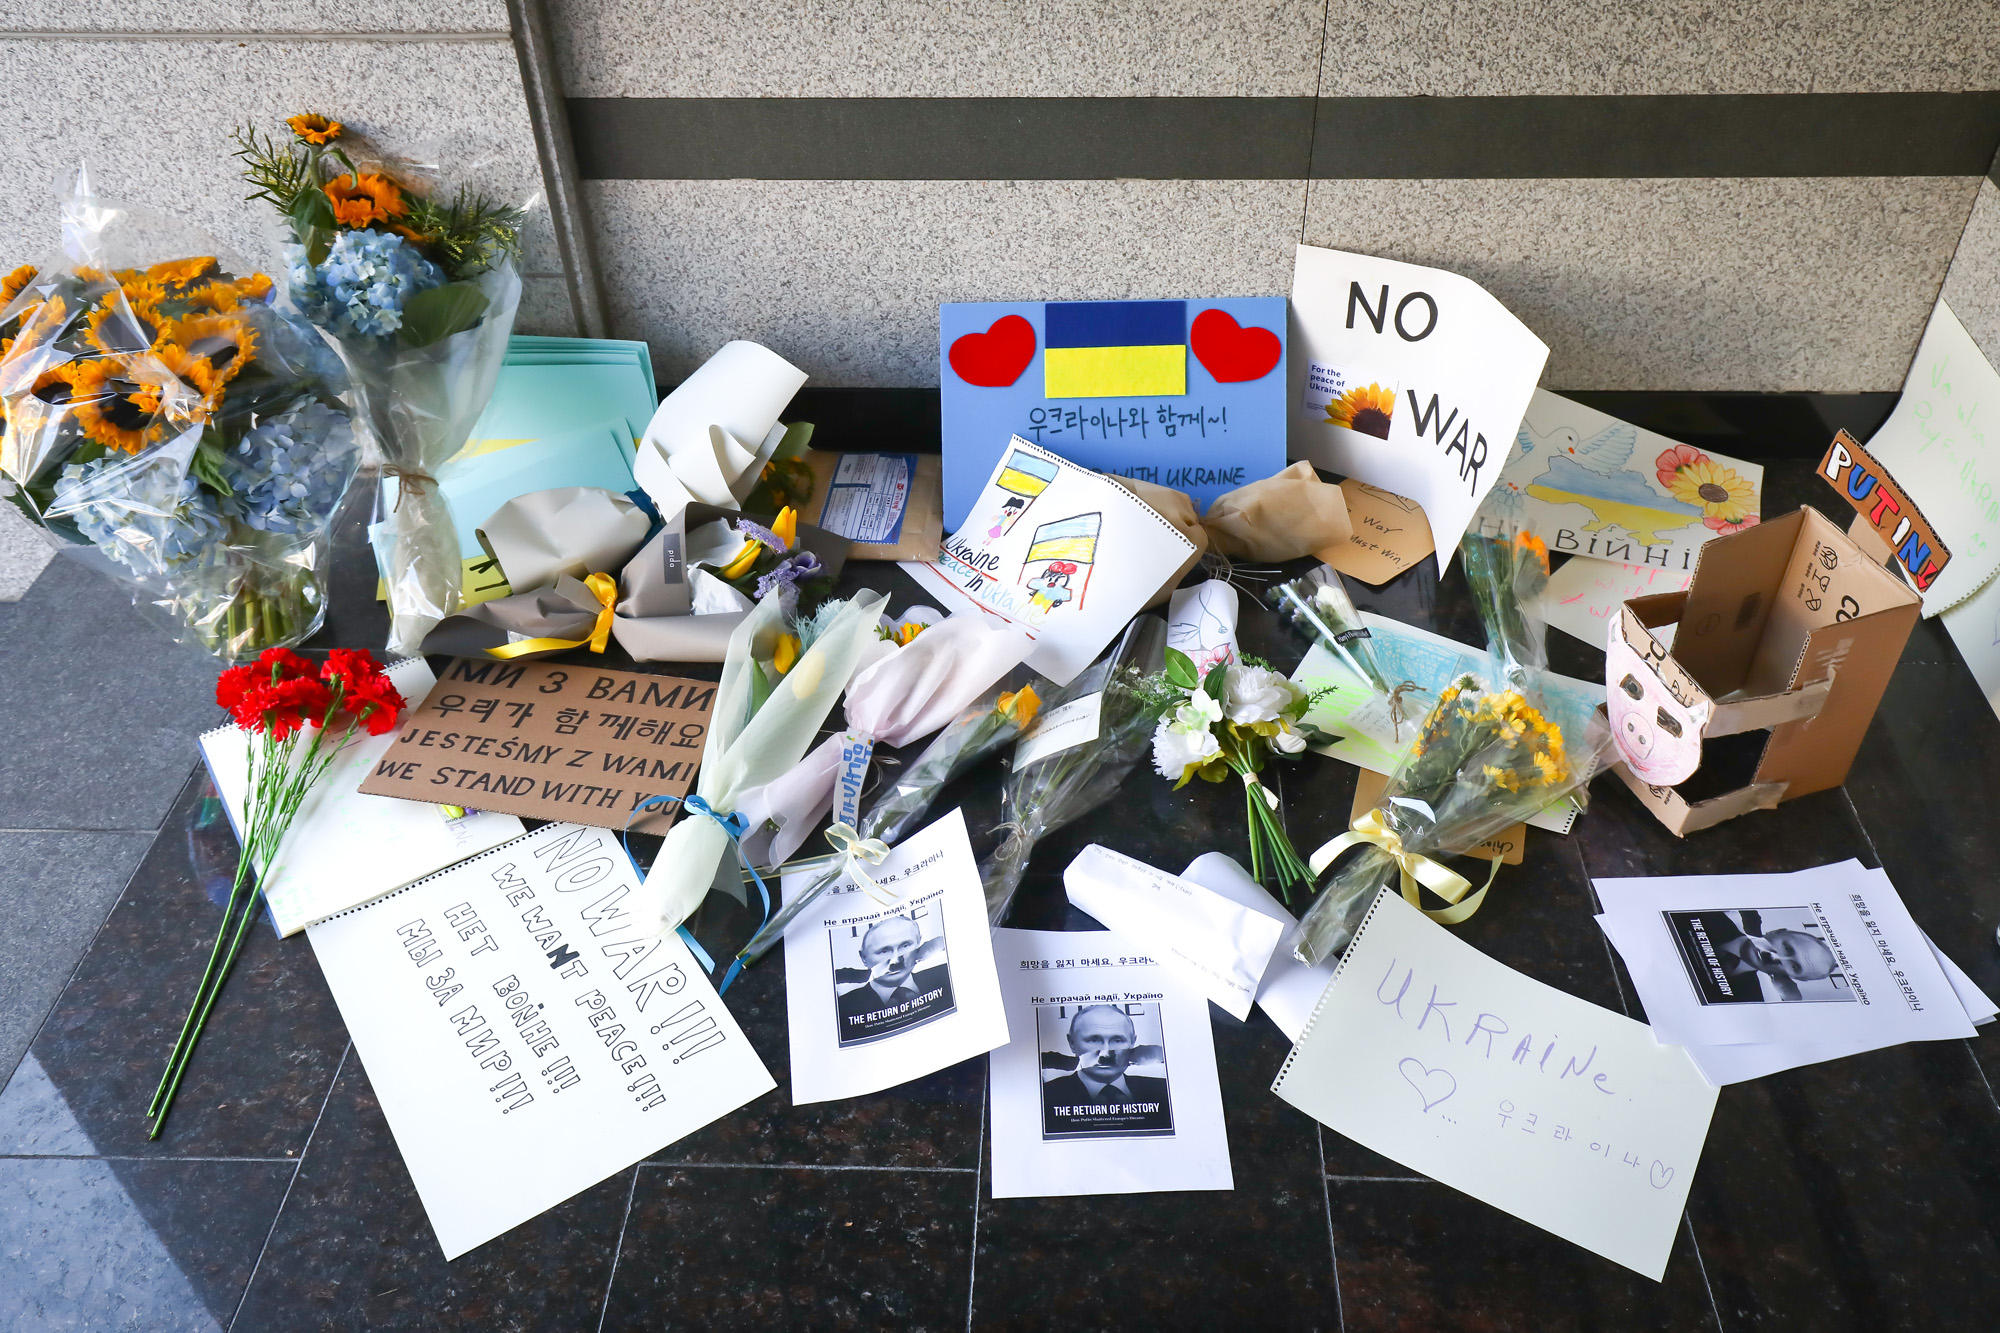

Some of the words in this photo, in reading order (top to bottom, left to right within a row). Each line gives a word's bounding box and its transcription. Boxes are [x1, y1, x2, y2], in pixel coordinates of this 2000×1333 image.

[1346, 281, 1438, 342] NO
[1310, 374, 1334, 387] peace
[1336, 378, 1346, 388] of
[1311, 364, 1326, 375] For
[1327, 368, 1341, 378] the
[1029, 405, 1149, 441] 우크라이나와
[1407, 389, 1488, 497] WAR
[1166, 467, 1245, 487] UKRAINE
[1363, 516, 1403, 534] War
[1824, 441, 1938, 590] PUTIN!
[946, 538, 1000, 571] Ukraine
[451, 661, 529, 689] МИ
[585, 676, 718, 712] ВАМИ
[431, 694, 536, 728] 우리가
[555, 707, 705, 749] 함께해요
[400, 728, 564, 764] JESTEŚMY
[566, 749, 593, 768] Z
[602, 753, 696, 782] WAMI
[376, 760, 421, 780] WE
[430, 766, 536, 797] STAND
[541, 780, 623, 809] WITH
[534, 827, 614, 893] NO
[492, 862, 536, 907] WE
[521, 905, 588, 979] WANT
[842, 912, 881, 924] втрачай
[910, 889, 944, 907] Україно
[1690, 918, 1704, 931] THE
[444, 902, 499, 956] НЕТ
[1696, 932, 1716, 957] RETURN
[397, 919, 443, 968] МЫ
[426, 967, 464, 1007] ЗА
[1020, 960, 1049, 969] 희망을
[1056, 959, 1074, 968] 잃지
[1708, 958, 1720, 967] OF
[1812, 902, 1822, 913] Не
[1820, 916, 1841, 948] втрачай
[1849, 973, 1870, 1006] Україно
[1851, 894, 1871, 917] 희망을
[1865, 920, 1882, 936] 잃지
[1894, 970, 1924, 1012] 우크라이나
[1050, 994, 1091, 1004] втрачай
[1124, 992, 1163, 1001] Україно
[1712, 968, 1734, 996] HISTORY
[849, 1015, 866, 1026] THE
[867, 1006, 898, 1023] RETURN
[900, 1002, 910, 1012] OF
[911, 988, 943, 1009] HISTORY
[1053, 1106, 1071, 1116] THE
[1073, 1105, 1107, 1115] RETURN
[1110, 1104, 1121, 1114] OF
[1123, 1103, 1160, 1114] HISTORY
